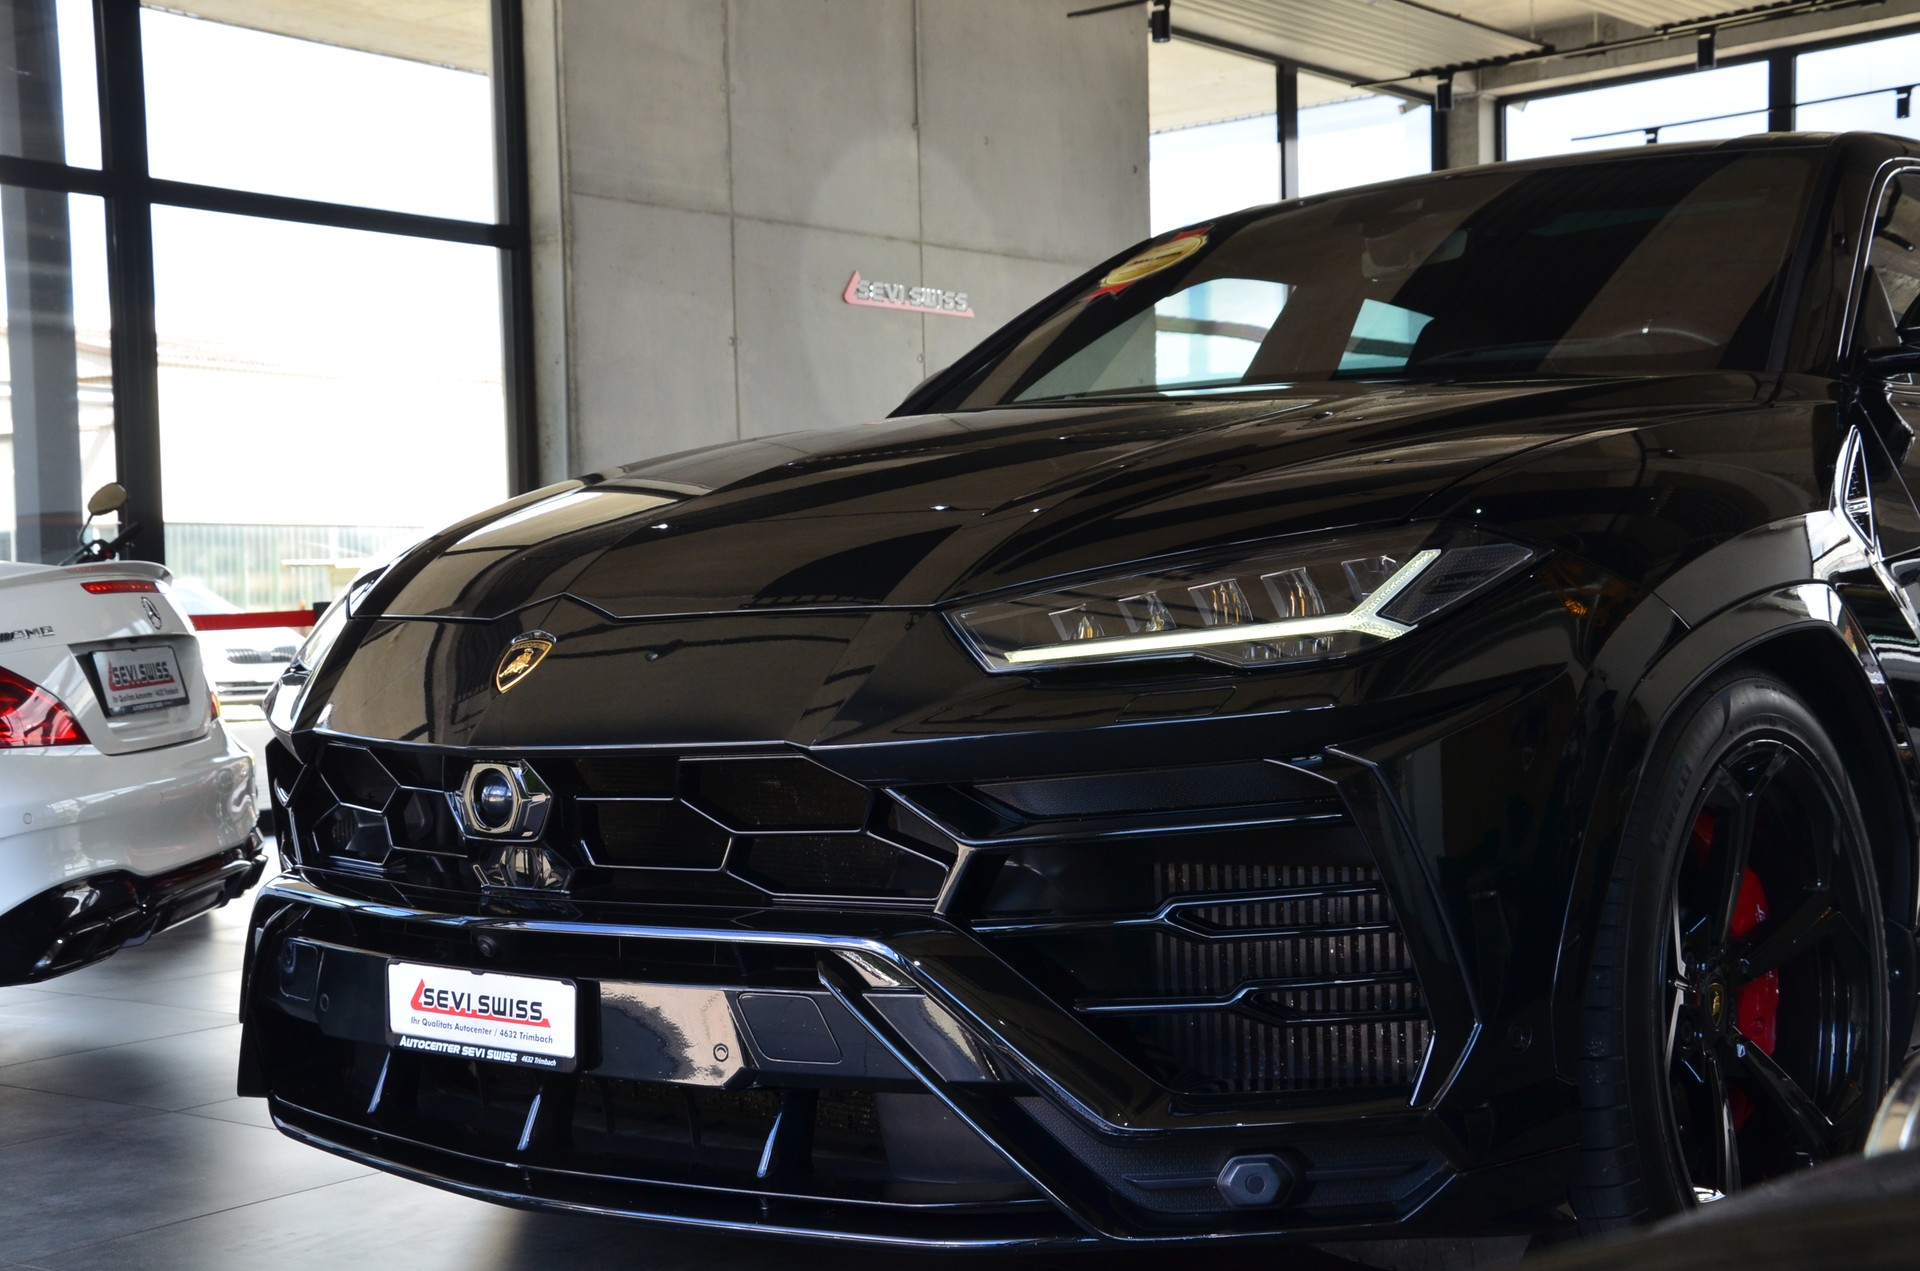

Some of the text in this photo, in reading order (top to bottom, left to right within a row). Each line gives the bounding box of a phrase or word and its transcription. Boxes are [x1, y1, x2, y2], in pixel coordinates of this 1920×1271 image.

[857, 280, 968, 312] SEVI SWISS
[423, 987, 543, 1021] SEVI SWISS
[410, 1016, 421, 1025] Ihr
[454, 1022, 492, 1036] Autocenter
[499, 1029, 518, 1039] 4632
[519, 1031, 554, 1044] Trimbach
[399, 1035, 460, 1054] AUTOCENTER
[461, 1046, 486, 1059] SEVI
[486, 1049, 518, 1063] SWISS
[521, 1055, 534, 1064] 4632
